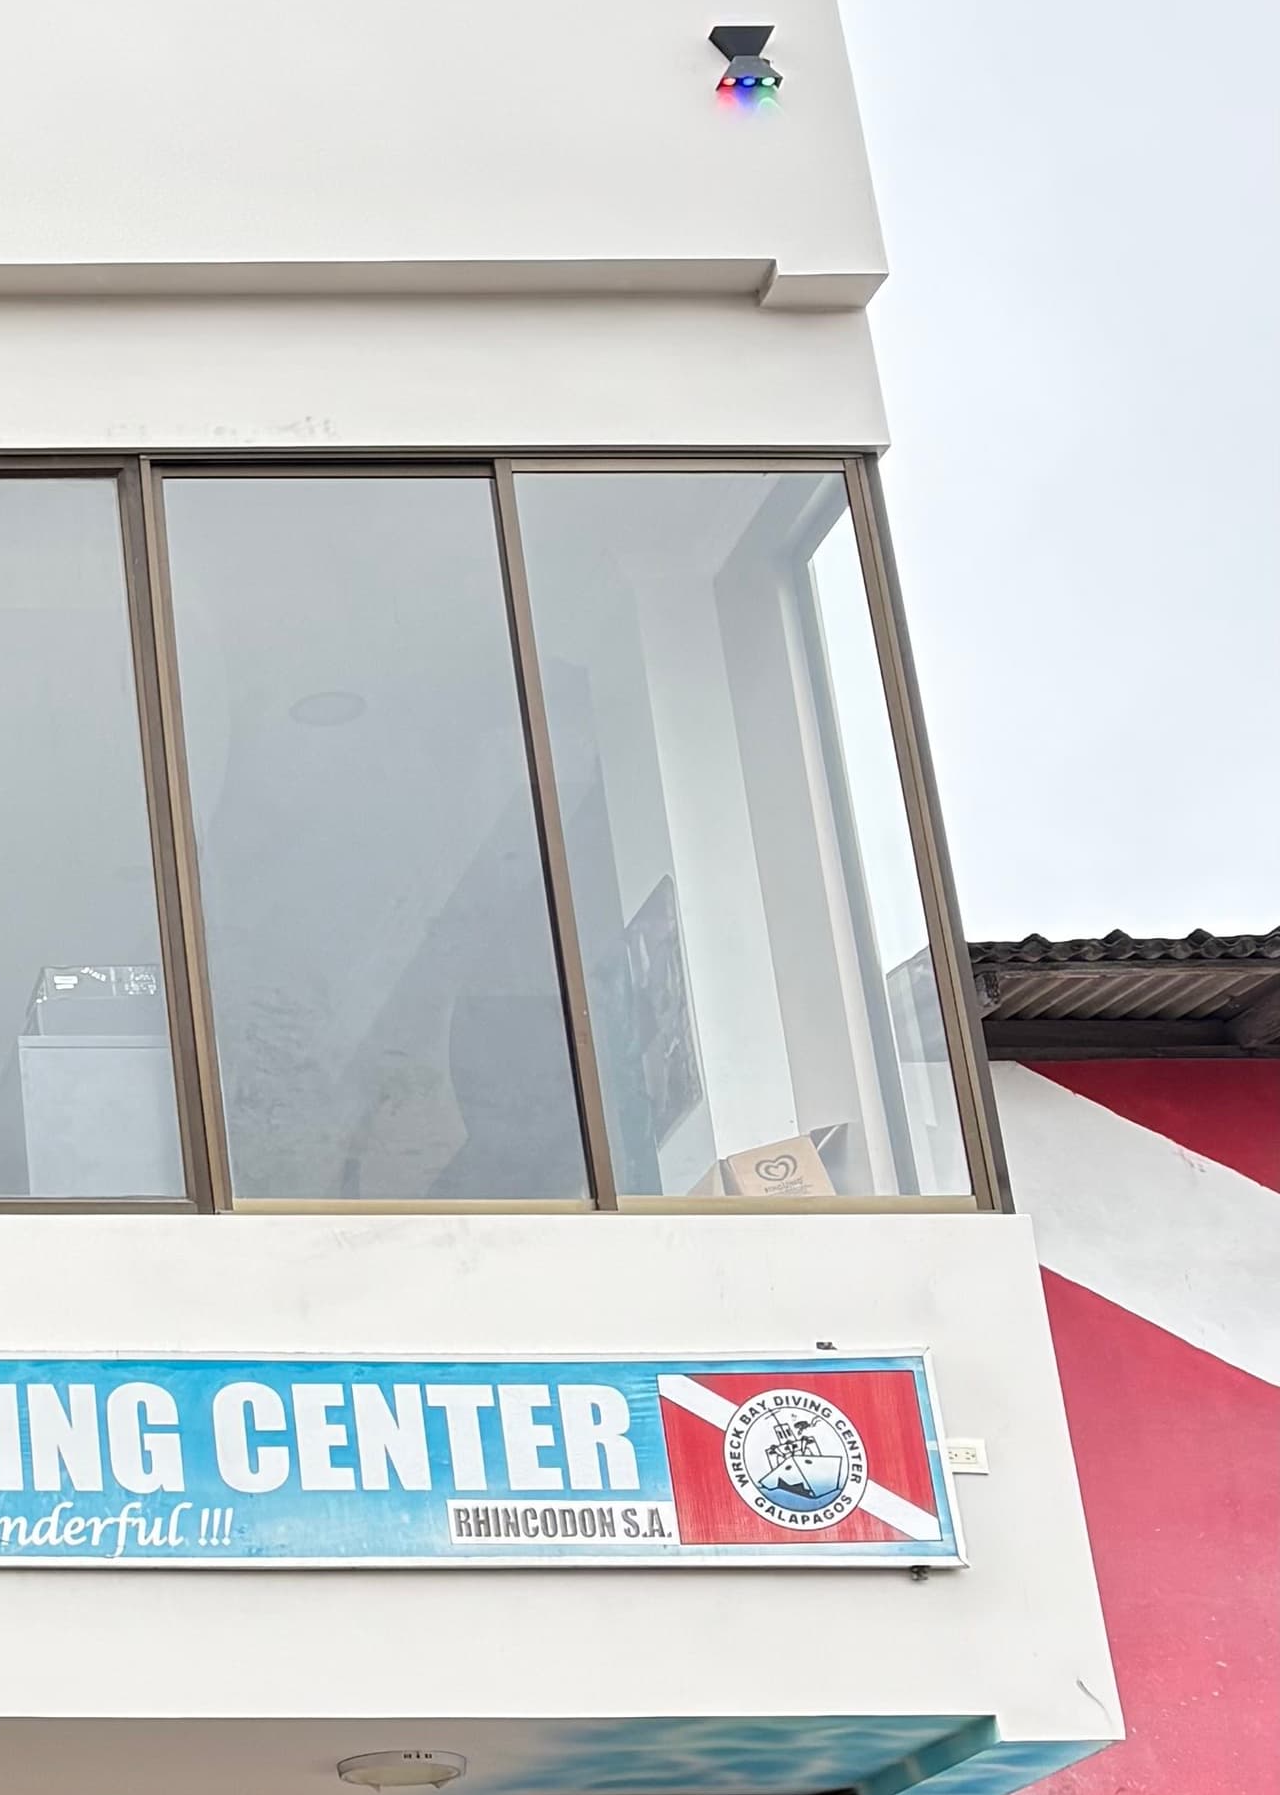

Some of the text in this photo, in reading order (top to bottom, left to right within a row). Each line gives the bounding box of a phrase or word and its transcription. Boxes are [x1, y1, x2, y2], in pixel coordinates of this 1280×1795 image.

[213, 1381, 640, 1494] CENTER
[729, 1395, 863, 1488] WRECK BAY DIVING CENTER
[454, 1507, 675, 1540] RHINCODON S.A.
[754, 1494, 853, 1525] GALAPAGOS
